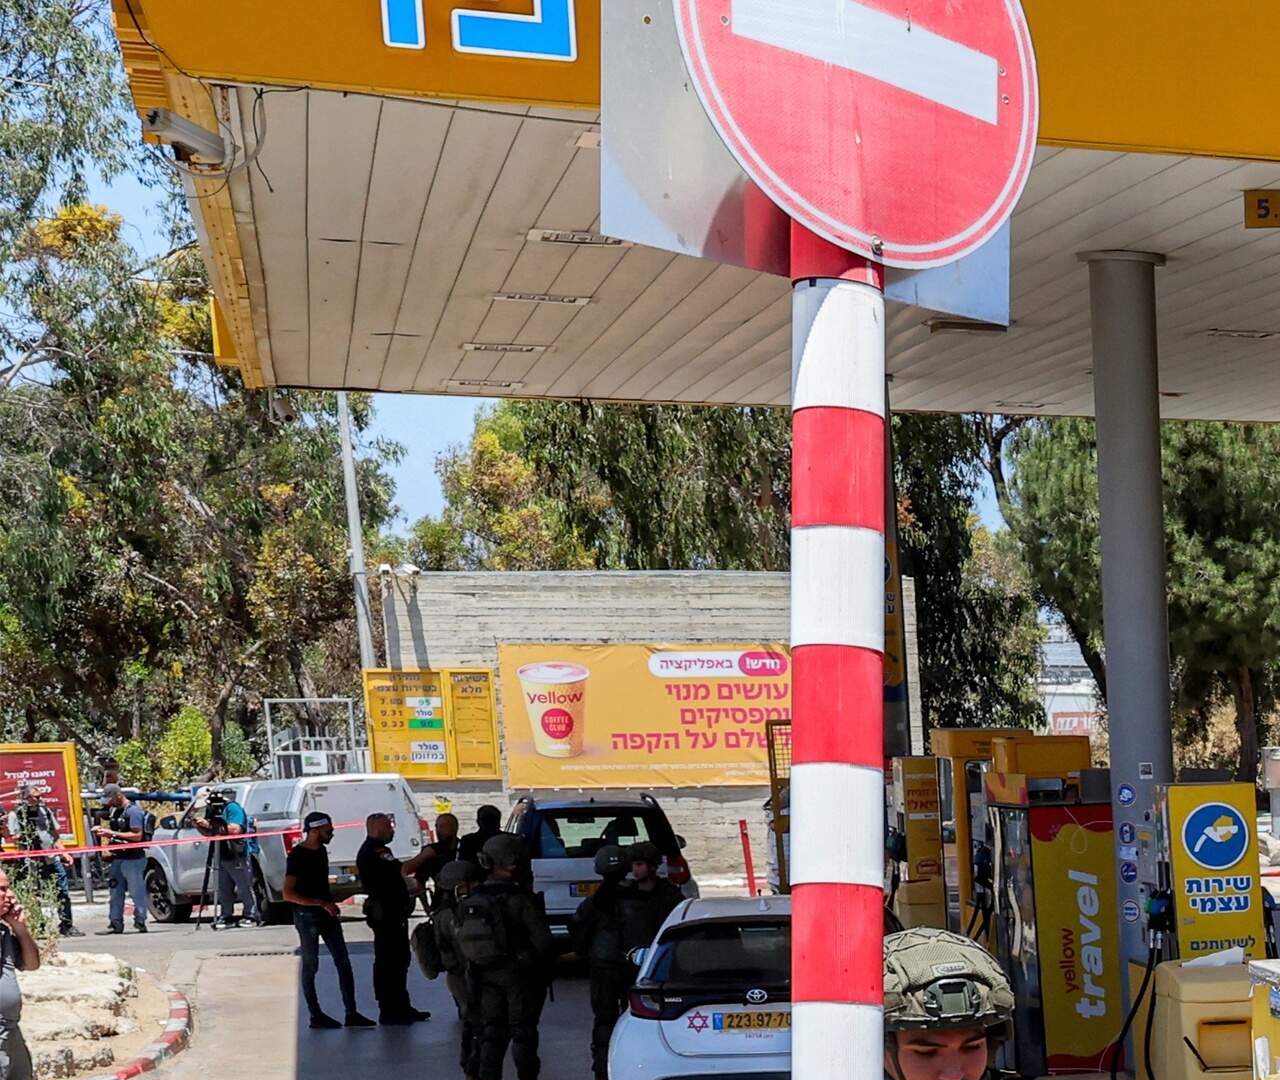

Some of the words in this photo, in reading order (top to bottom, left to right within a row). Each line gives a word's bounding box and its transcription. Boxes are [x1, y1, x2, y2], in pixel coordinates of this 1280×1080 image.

[659, 657, 734, 671] באפליקציה
[526, 691, 584, 705] yellow
[664, 683, 711, 701] מנוי
[717, 683, 788, 701] עושים
[611, 731, 679, 755] הקפה
[685, 728, 717, 750] על
[1185, 876, 1252, 895] שירות
[1189, 894, 1250, 914] עצמי
[1068, 870, 1106, 1019] travel
[1060, 928, 1079, 994] yellow
